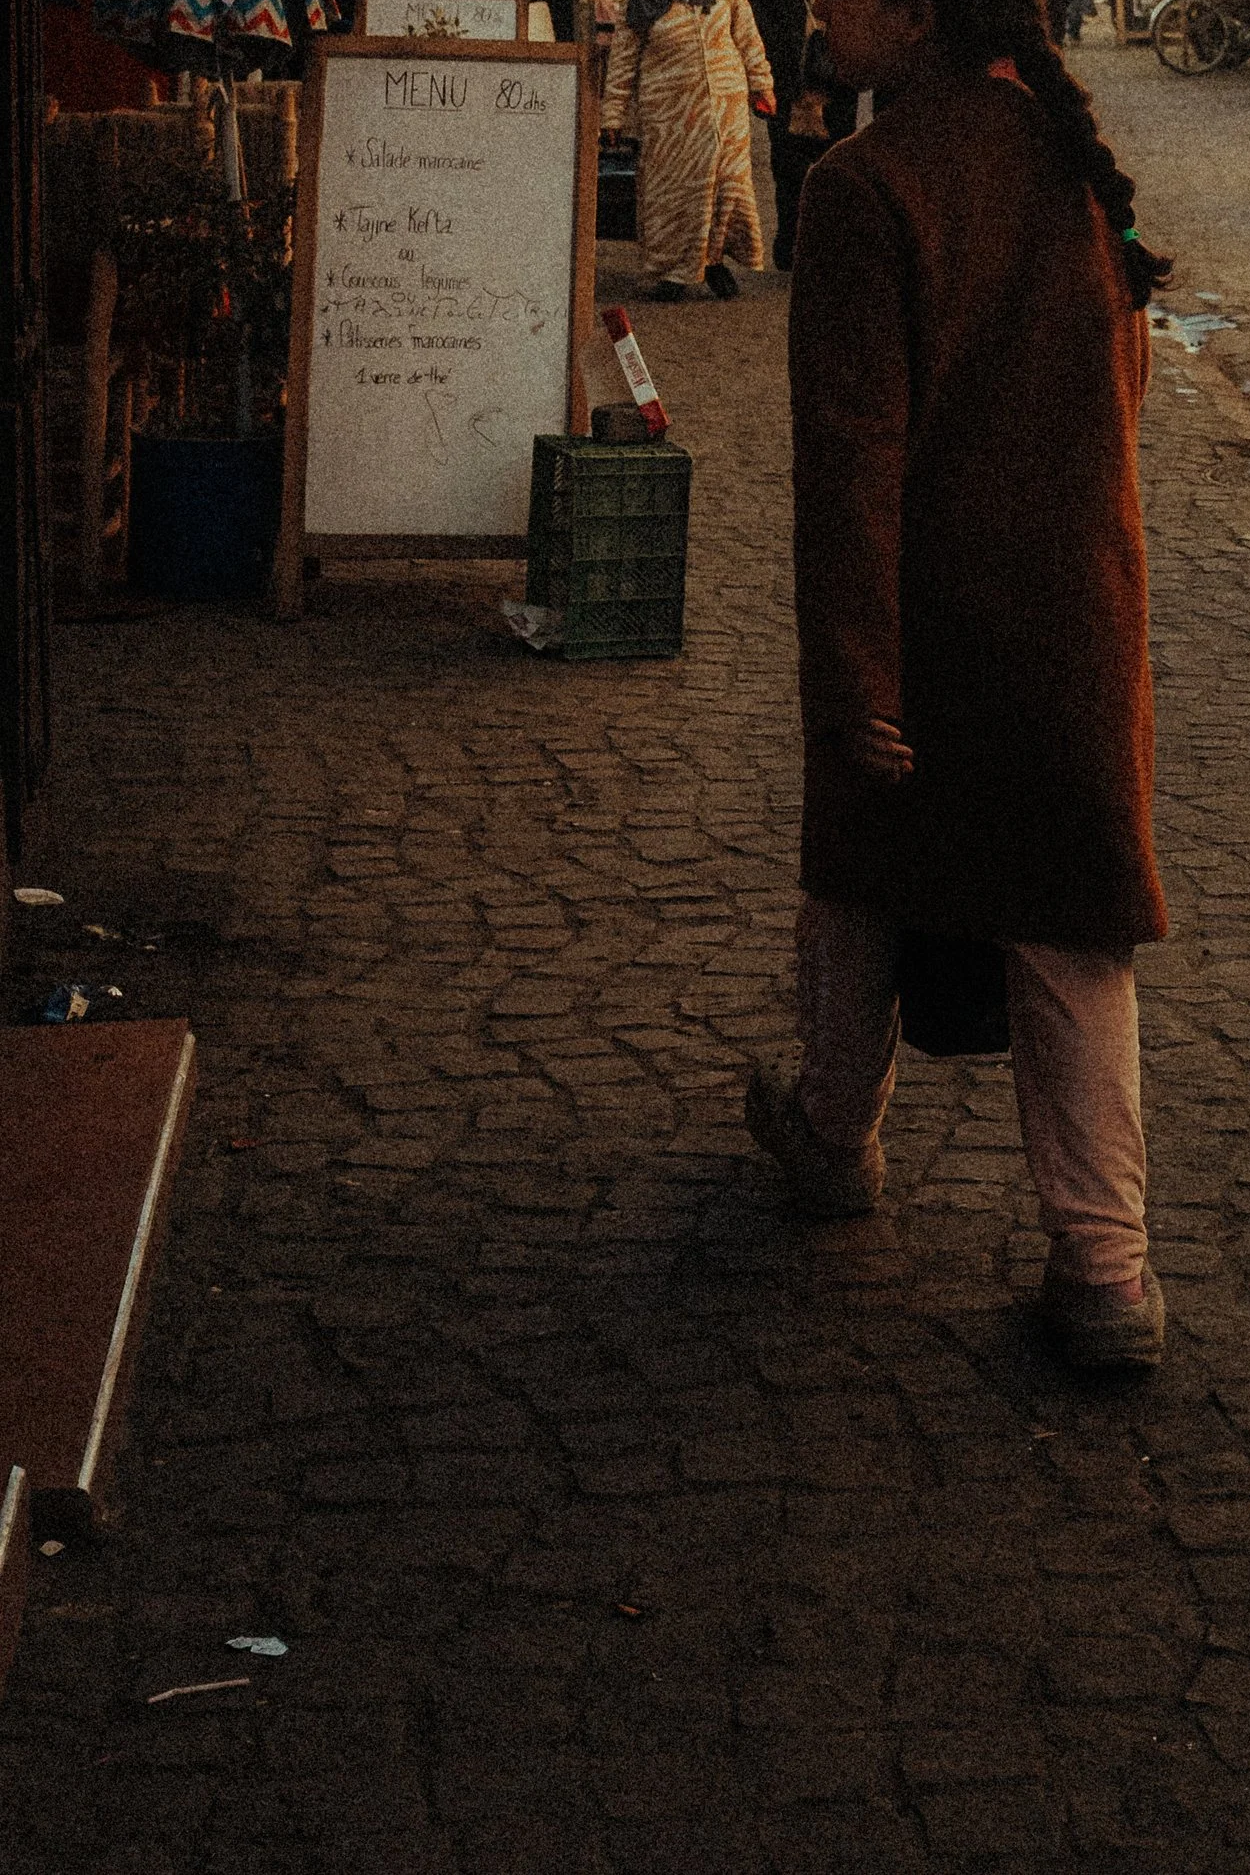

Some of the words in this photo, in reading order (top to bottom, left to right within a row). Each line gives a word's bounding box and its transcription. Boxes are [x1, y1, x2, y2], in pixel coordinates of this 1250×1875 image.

[385, 71, 468, 108] MENU
[360, 136, 411, 169] Salade
[417, 155, 483, 172] marocaine
[408, 205, 453, 234] Kefta
[370, 372, 401, 385] verre
